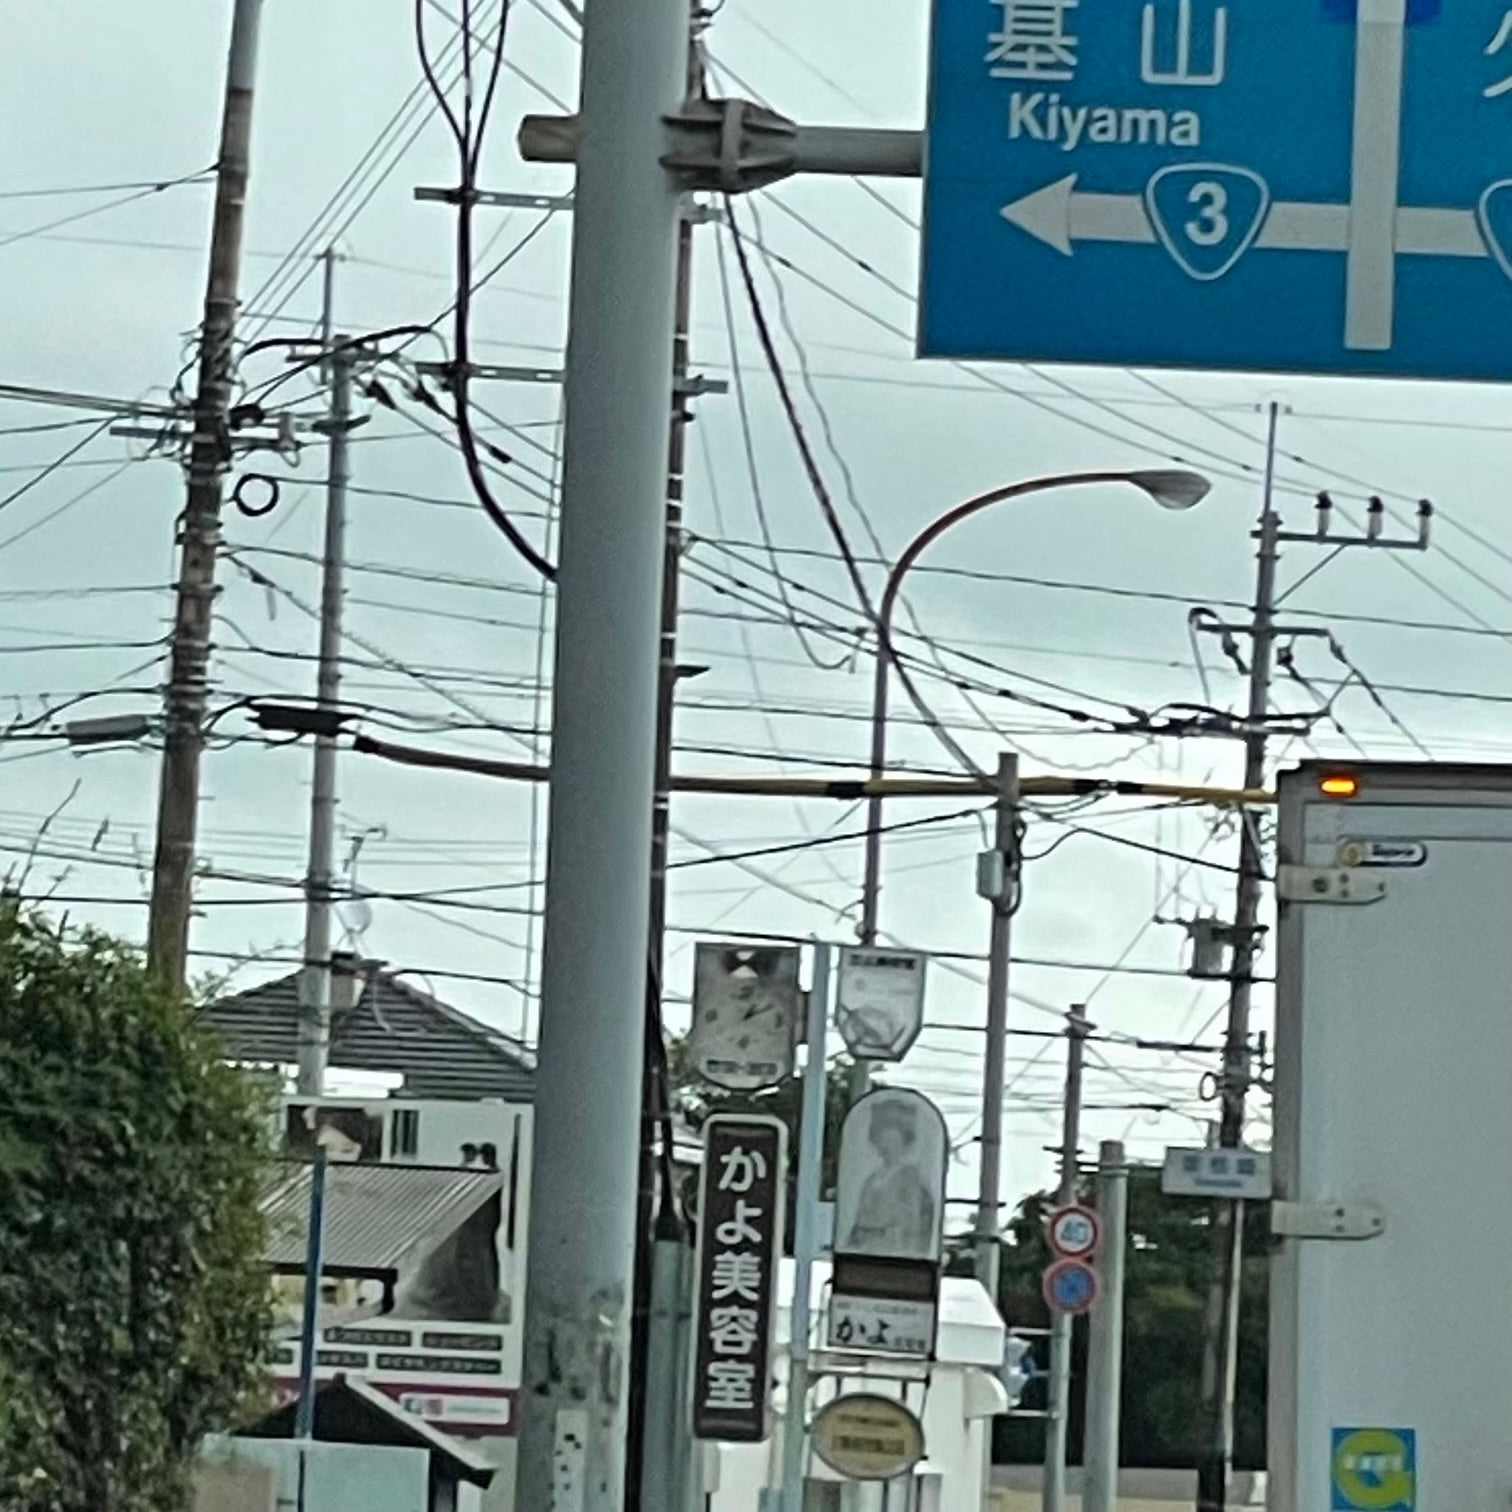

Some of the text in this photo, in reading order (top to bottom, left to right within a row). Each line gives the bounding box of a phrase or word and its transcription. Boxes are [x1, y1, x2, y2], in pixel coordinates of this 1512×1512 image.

[1008, 92, 1200, 151] Kiyama
[1185, 182, 1229, 246] 3
[704, 1146, 767, 1409] かよ美容室
